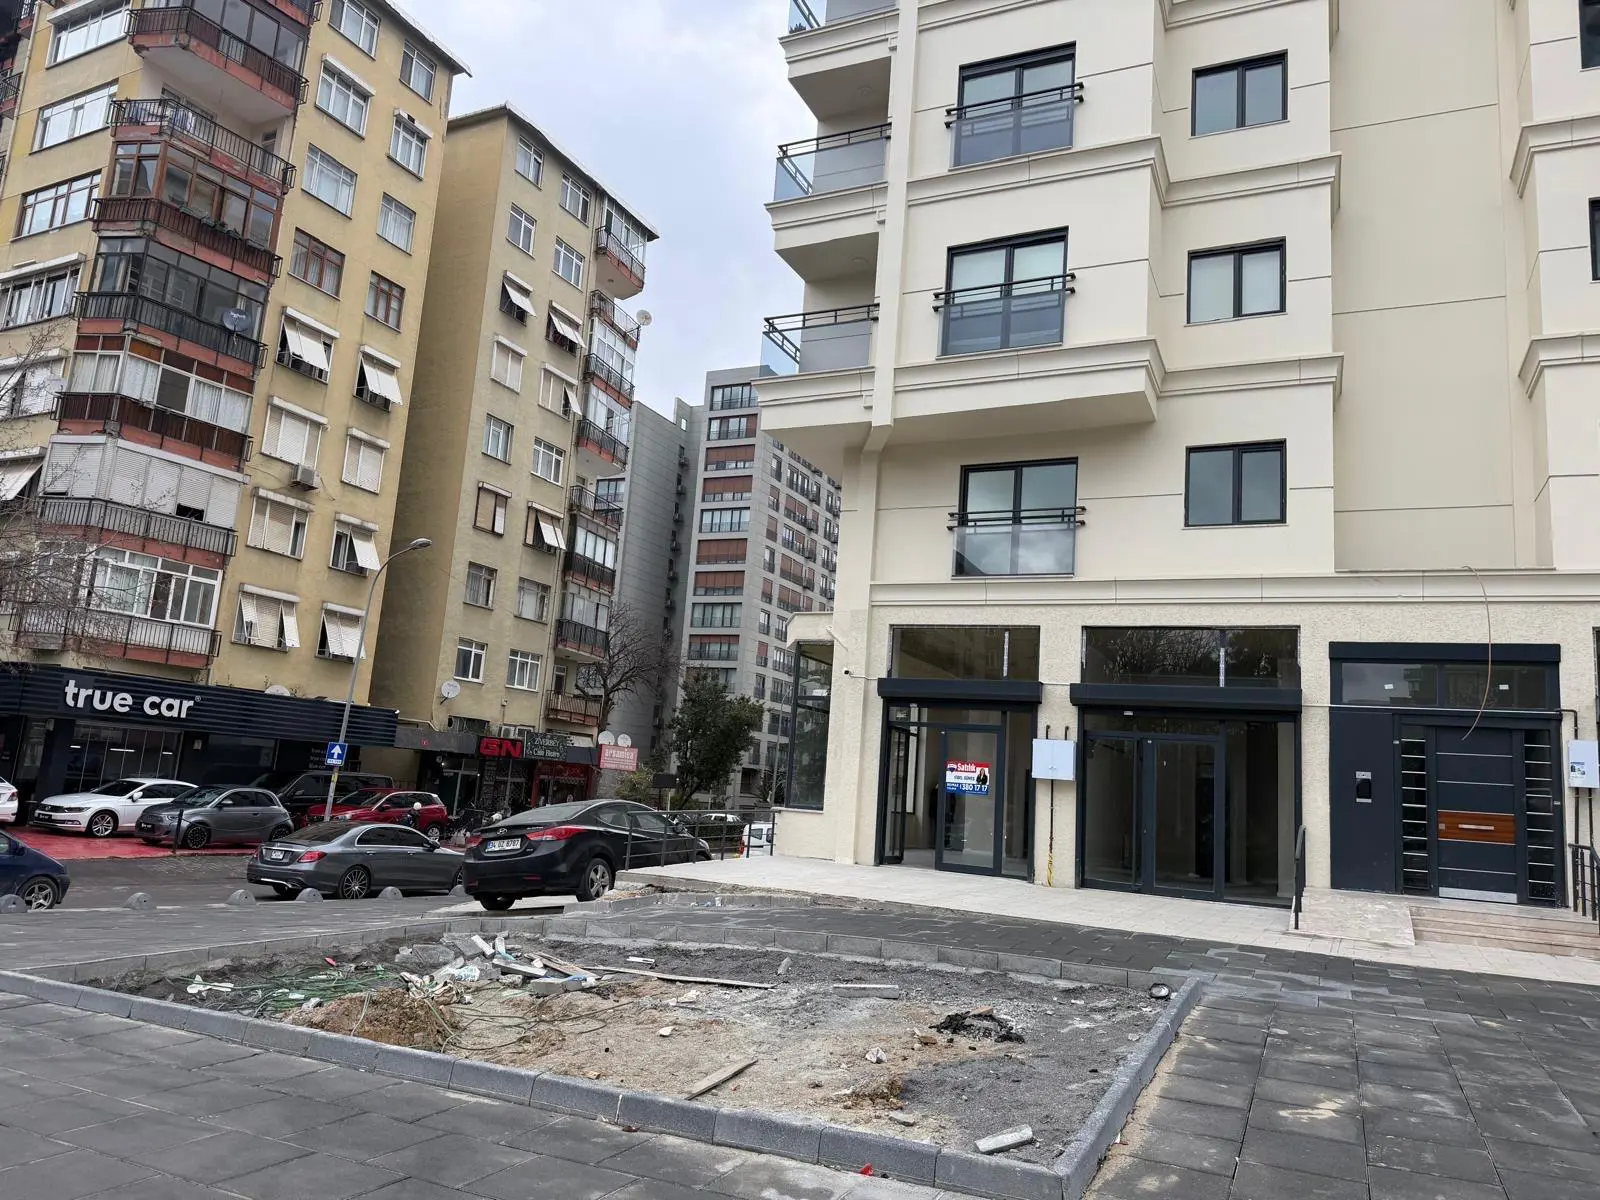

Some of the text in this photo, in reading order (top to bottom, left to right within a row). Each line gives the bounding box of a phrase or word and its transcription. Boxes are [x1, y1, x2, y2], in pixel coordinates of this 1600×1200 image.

[65, 680, 194, 718] true car
[974, 784, 981, 792] 17
